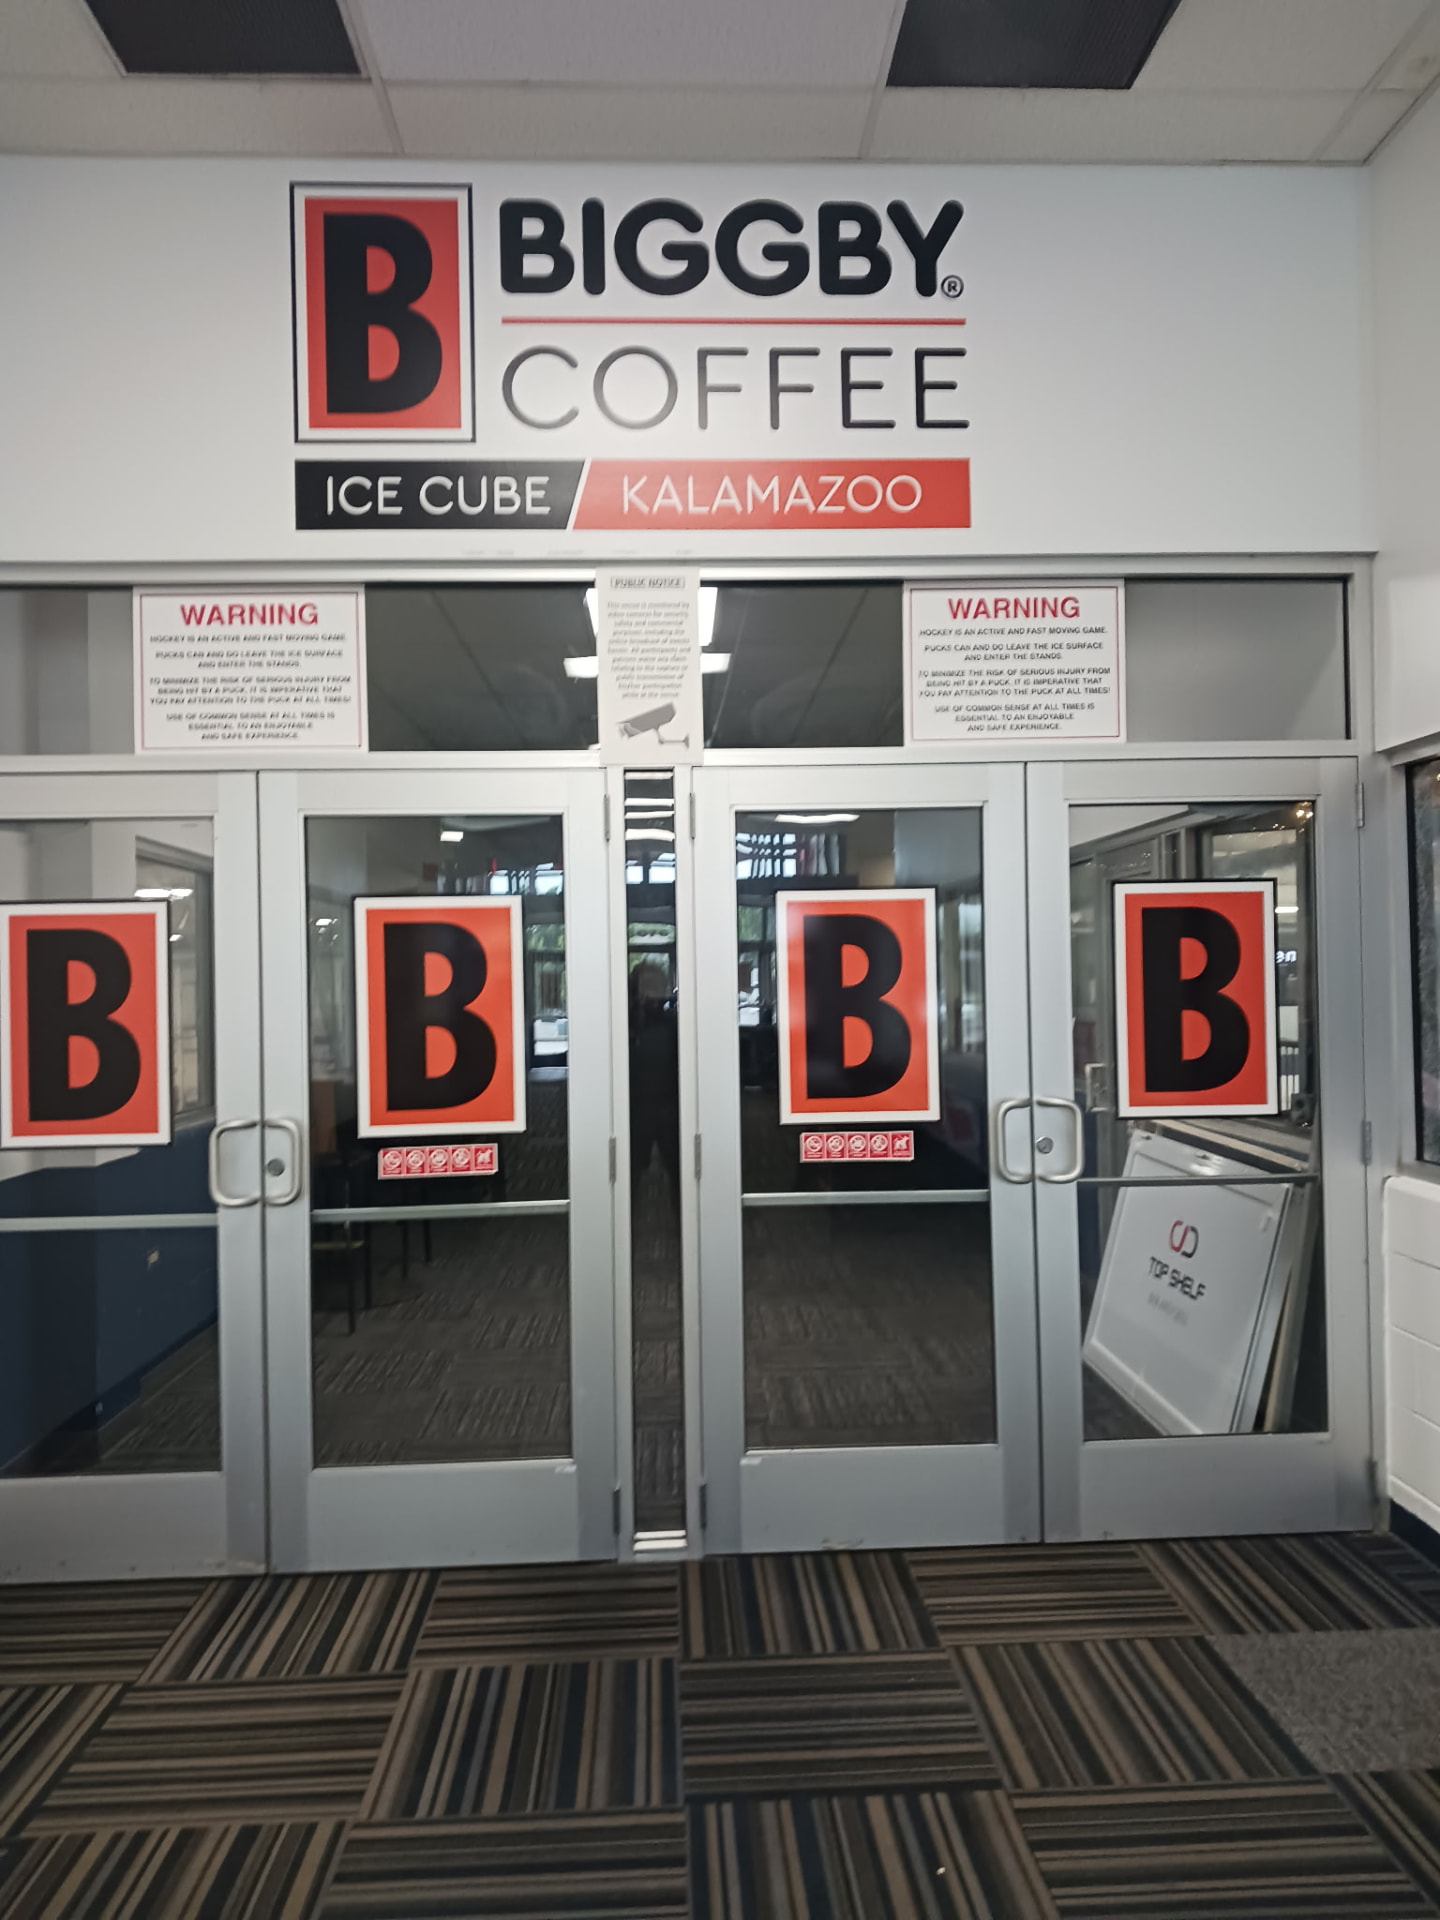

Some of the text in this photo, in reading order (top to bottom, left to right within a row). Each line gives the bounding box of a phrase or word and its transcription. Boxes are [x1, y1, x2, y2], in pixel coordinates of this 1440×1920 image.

[322, 213, 442, 414] B
[501, 344, 970, 430] COFFEE
[326, 474, 551, 515] ICE CUBE
[622, 474, 923, 515] KALAMAZOO
[180, 603, 318, 626] WARNING
[948, 596, 1080, 619] WARNING
[919, 628, 952, 637] HOCKEY
[954, 628, 962, 636] IS
[964, 628, 975, 636] AN
[977, 627, 1005, 636] ACTIVE
[1007, 627, 1024, 636] AND
[1026, 627, 1046, 635] FAST
[1048, 626, 1080, 635] MOVING
[924, 642, 1104, 652] PUCKS CAN AND DO LEAVE THE ICE SURFACE
[964, 653, 981, 661] AND
[983, 653, 1010, 661] ENTER
[1012, 652, 1027, 661] THE
[919, 670, 928, 678] TO
[968, 669, 983, 677] THE
[985, 668, 1004, 677] RISK
[1006, 668, 1016, 677] OF
[1019, 668, 1055, 676] SERIOUS
[1056, 667, 1085, 676] INJURY
[1086, 667, 1111, 675] FROM
[926, 679, 950, 688] BEING
[953, 679, 965, 687] HIT
[967, 679, 977, 687] BY
[980, 679, 985, 687] A
[1014, 678, 1020, 686] IT
[1023, 678, 1030, 686] IS
[1032, 677, 1080, 686] IMPERATIVE
[1082, 677, 1102, 686] THAT
[919, 689, 935, 698] YOU
[937, 689, 951, 697] PAY
[954, 688, 998, 697] ATTENTION
[1001, 688, 1011, 696] TO
[1013, 688, 1028, 696] THE
[1030, 687, 1052, 696] PUCK
[1054, 687, 1064, 695] AT
[1066, 687, 1080, 695] ALL
[935, 702, 1095, 713] USE OF COMMON SENSE AT ALL TIMES IS
[955, 712, 1074, 722] ESSENTIAL TO AN ENJOYABLE
[967, 724, 984, 732] AND
[986, 723, 1006, 732] SAFE
[803, 913, 912, 1099] B
[1141, 906, 1250, 1093] B
[27, 928, 141, 1121] B
[383, 922, 497, 1110] B
[1149, 1256, 1206, 1300] TOP SHELF
